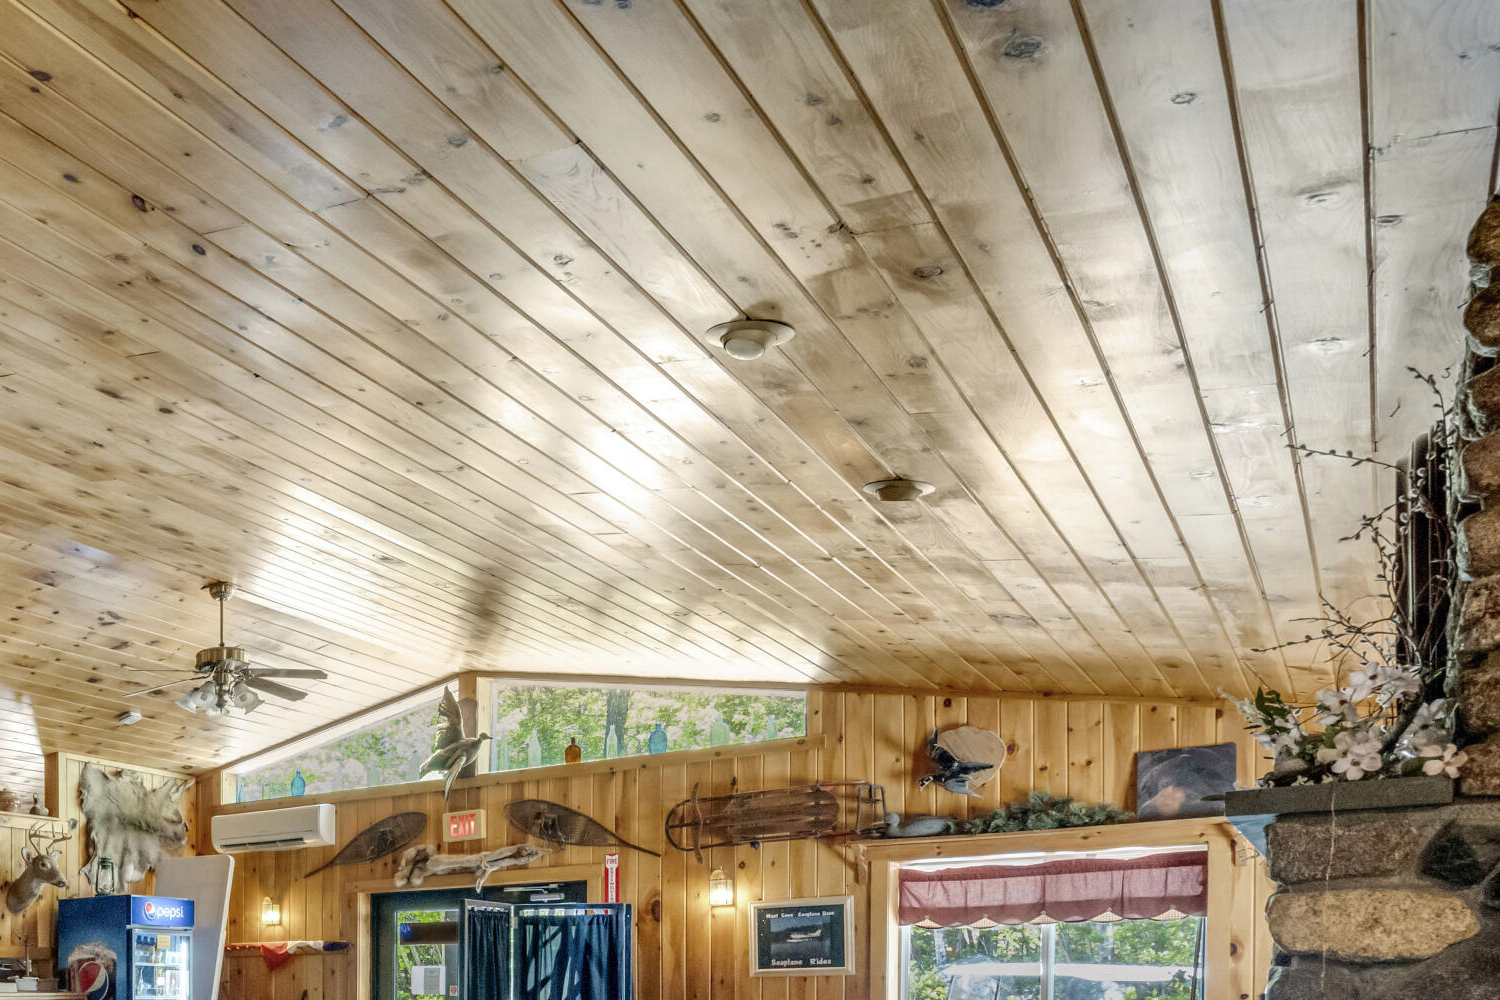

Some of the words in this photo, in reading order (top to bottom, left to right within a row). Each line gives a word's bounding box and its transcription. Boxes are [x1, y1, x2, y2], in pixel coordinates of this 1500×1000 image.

[450, 813, 476, 837] EXIT
[156, 905, 184, 920] pepsi
[771, 959, 802, 967] Seaplane
